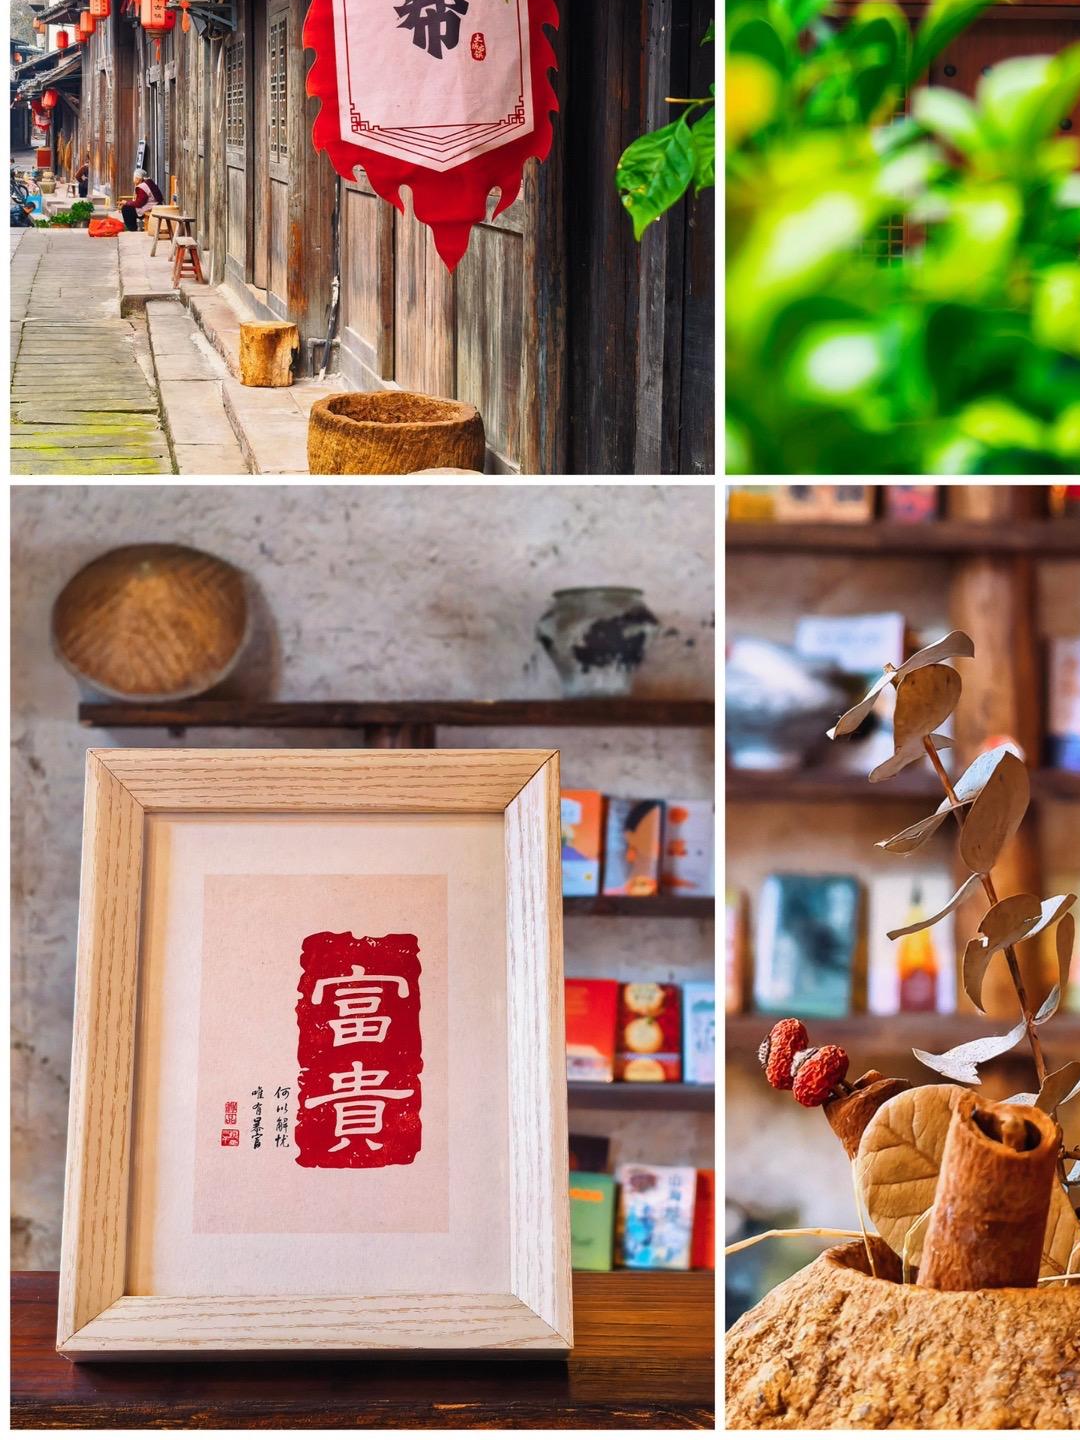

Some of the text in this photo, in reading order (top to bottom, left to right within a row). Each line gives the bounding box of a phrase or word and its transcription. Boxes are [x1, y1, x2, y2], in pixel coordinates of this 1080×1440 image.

[274, 1086, 291, 1148] 何以解忧
[304, 964, 415, 1153] 富貴
